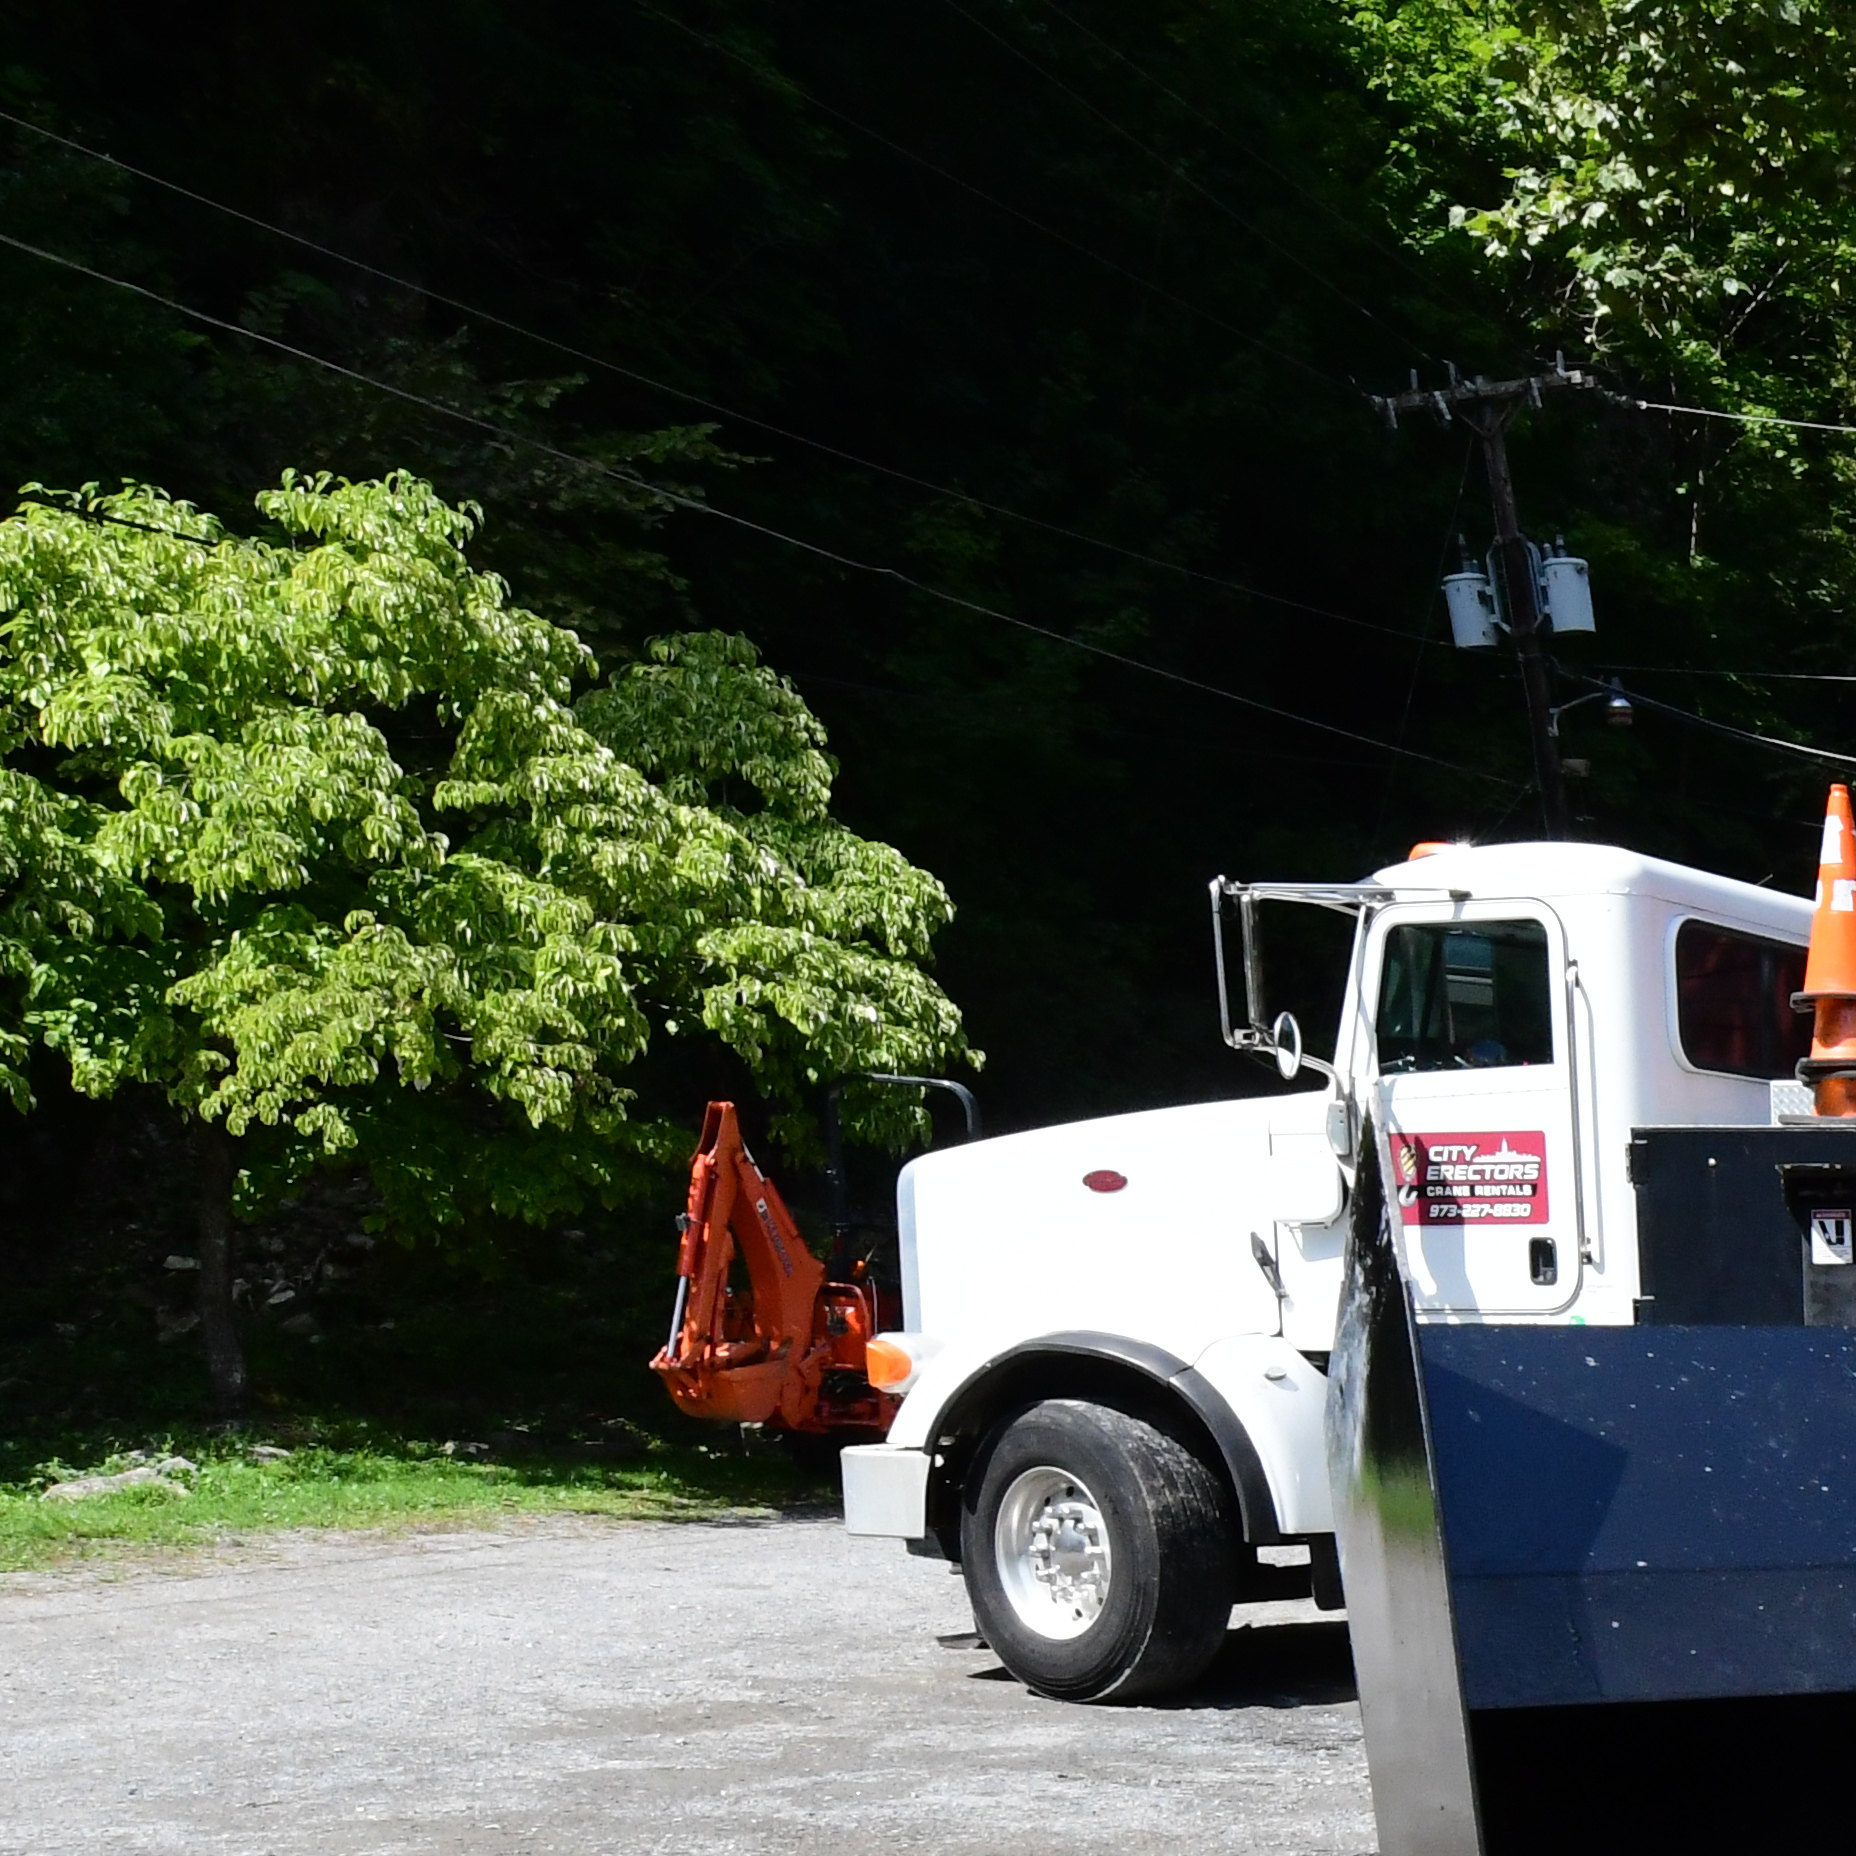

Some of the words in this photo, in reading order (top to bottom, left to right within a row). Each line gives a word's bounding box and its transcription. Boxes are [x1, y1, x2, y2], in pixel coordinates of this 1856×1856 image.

[1428, 1145, 1478, 1162] CITY
[1426, 1163, 1540, 1181] ERECTORS
[1426, 1185, 1471, 1197] CRANE
[1474, 1184, 1533, 1197] RENTALS
[1429, 1203, 1532, 1218] 973-227-8830
